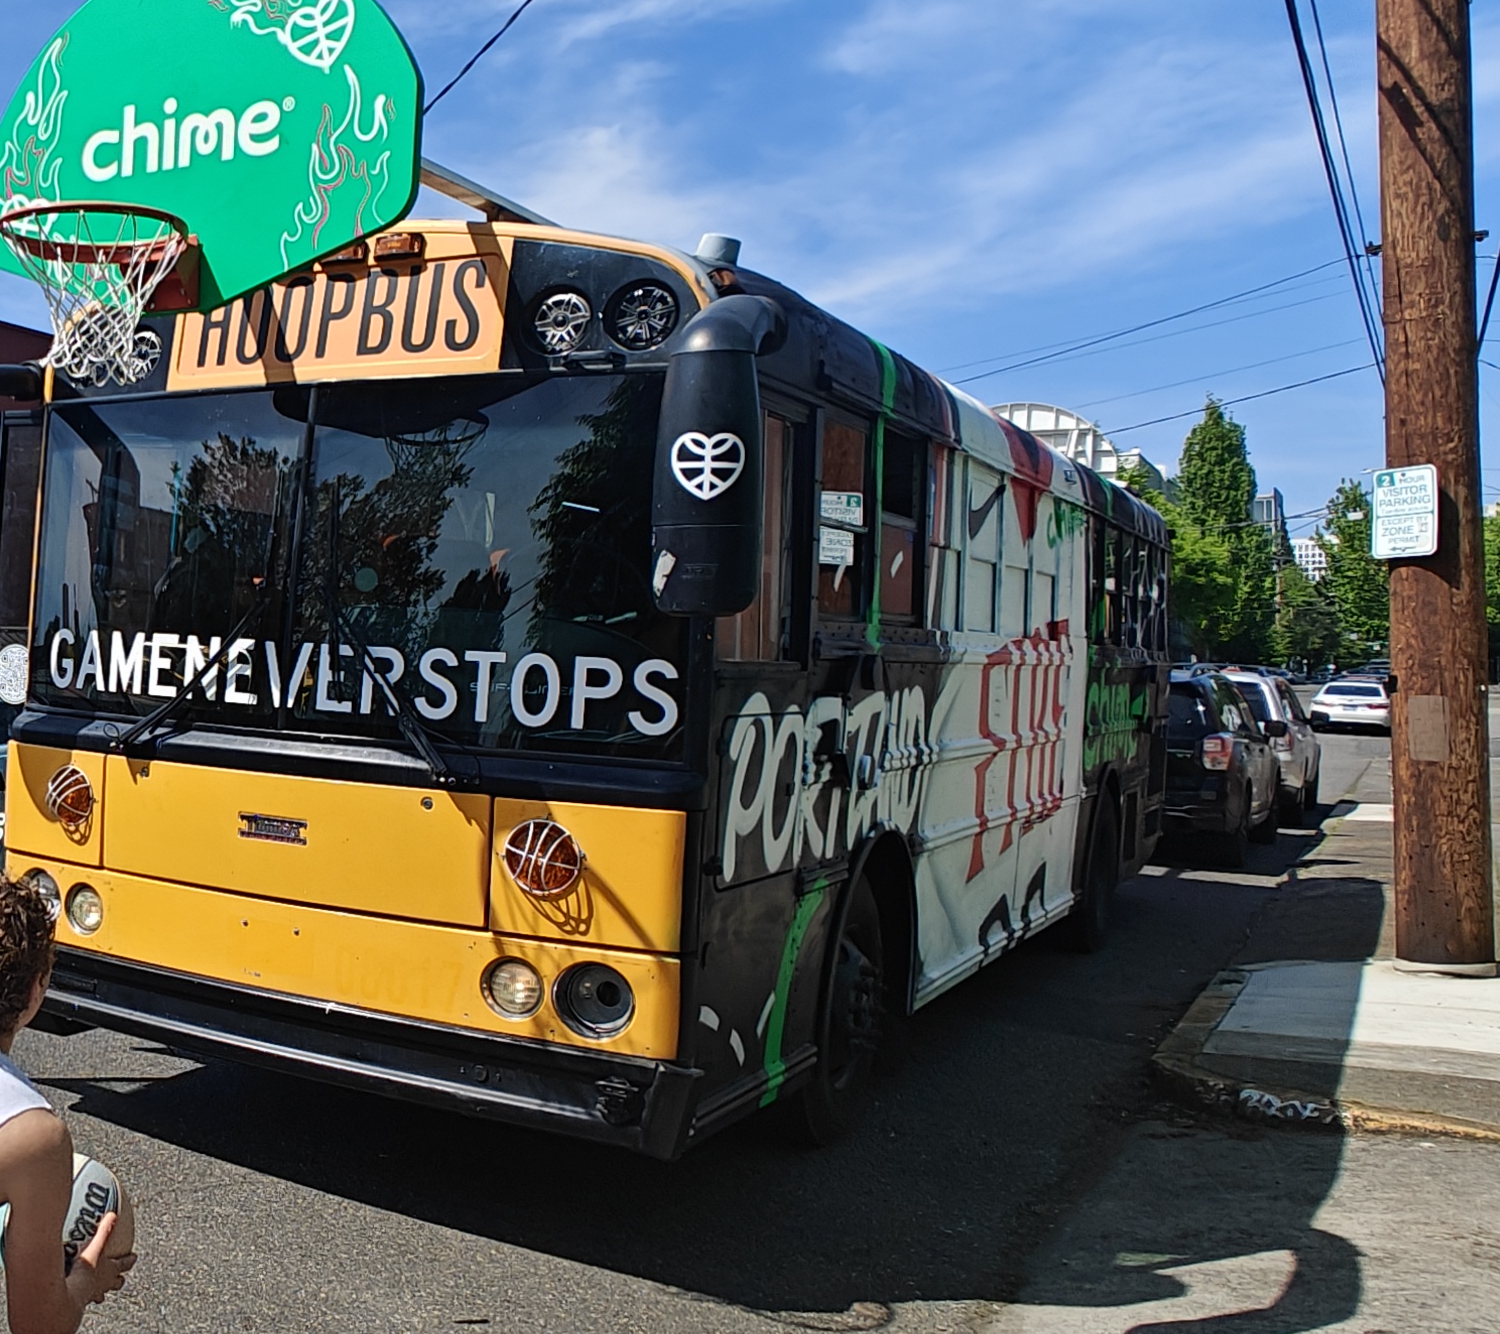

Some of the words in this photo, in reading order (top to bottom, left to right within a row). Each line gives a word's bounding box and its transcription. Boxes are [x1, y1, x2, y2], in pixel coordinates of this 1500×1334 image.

[81, 97, 281, 182] chime
[197, 259, 487, 368] HOOPBUS
[1381, 475, 1391, 487] 2
[1399, 475, 1425, 484] HOUR
[1382, 484, 1427, 498] VISITOR
[1379, 494, 1431, 508] PARKING
[1381, 516, 1414, 527] EXCEPT
[1381, 525, 1414, 537] ZONE
[1388, 535, 1420, 545] PERMIT
[63, 1182, 110, 1259] Wilso
